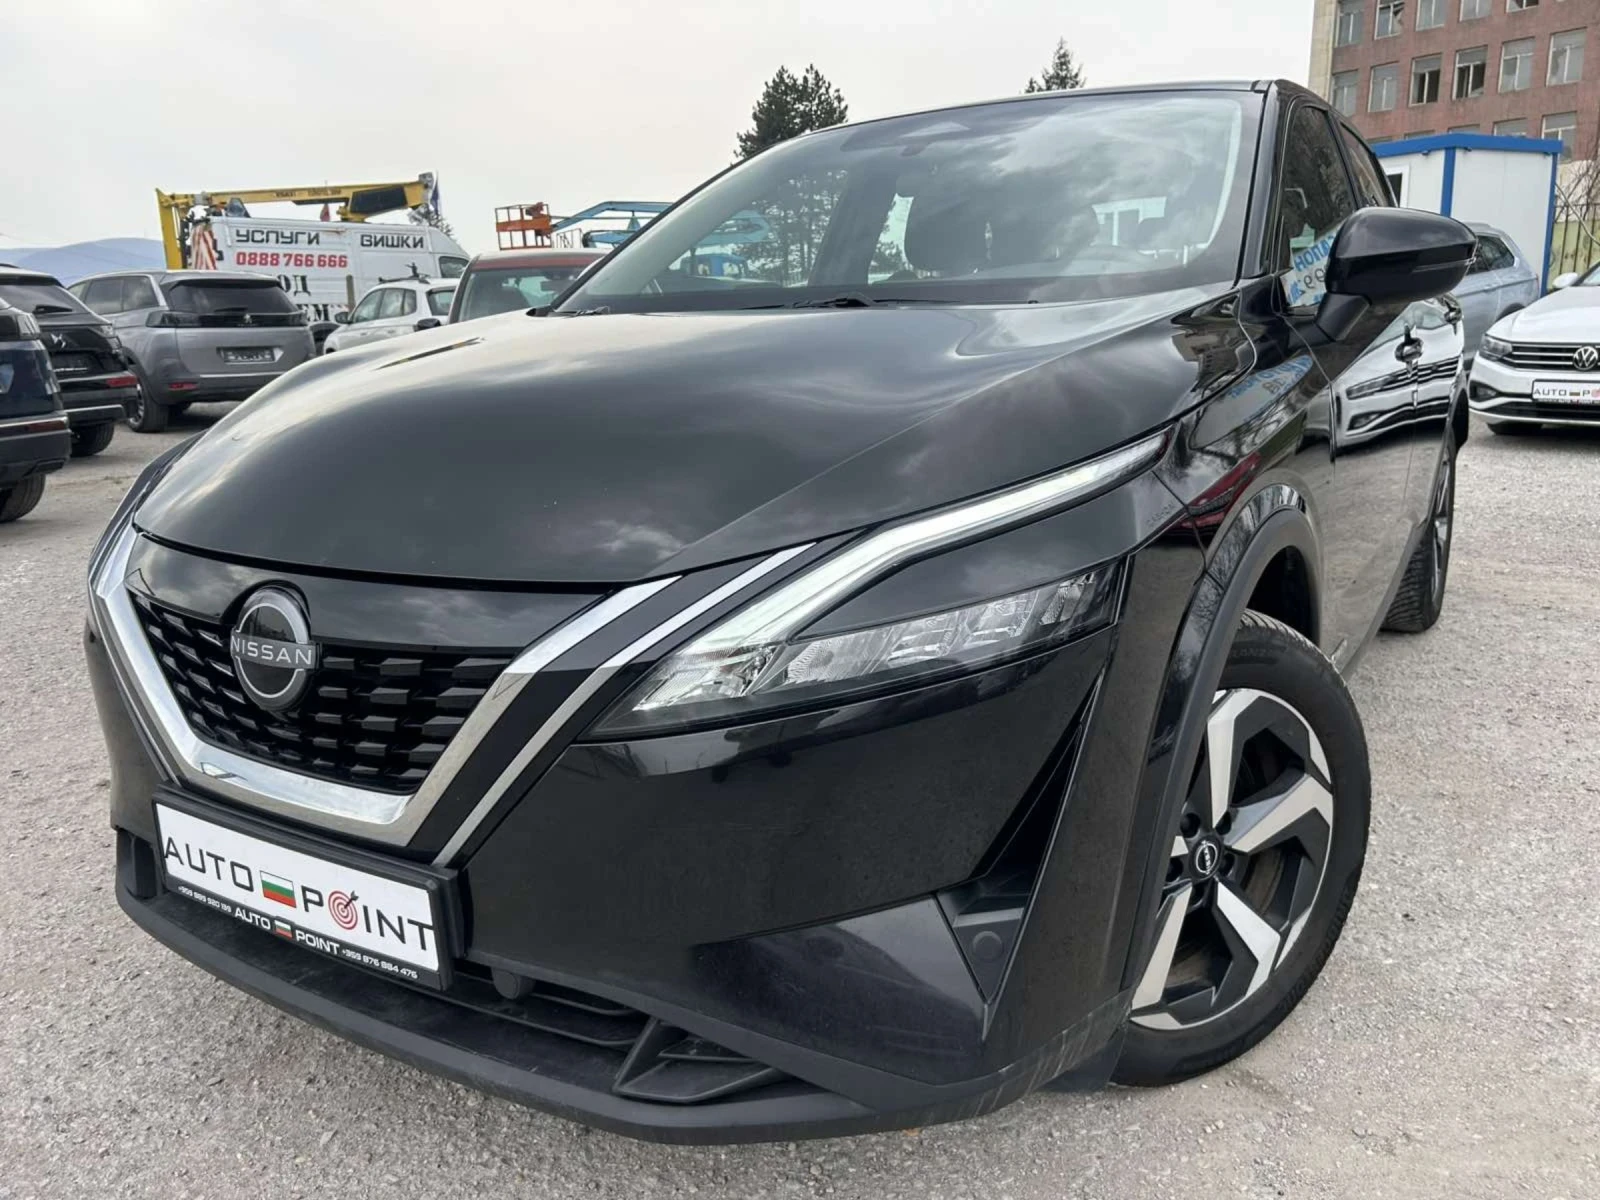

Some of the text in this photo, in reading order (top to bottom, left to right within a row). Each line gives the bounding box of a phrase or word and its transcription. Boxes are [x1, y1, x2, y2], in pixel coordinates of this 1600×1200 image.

[360, 234, 424, 249] ВИШКИ
[236, 251, 348, 268] 0888 766 666
[1533, 388, 1567, 396] AUTO
[231, 635, 312, 665] NISSAN
[164, 837, 254, 892] AUTO
[235, 907, 270, 930] AUTO
[295, 929, 340, 955] POINT
